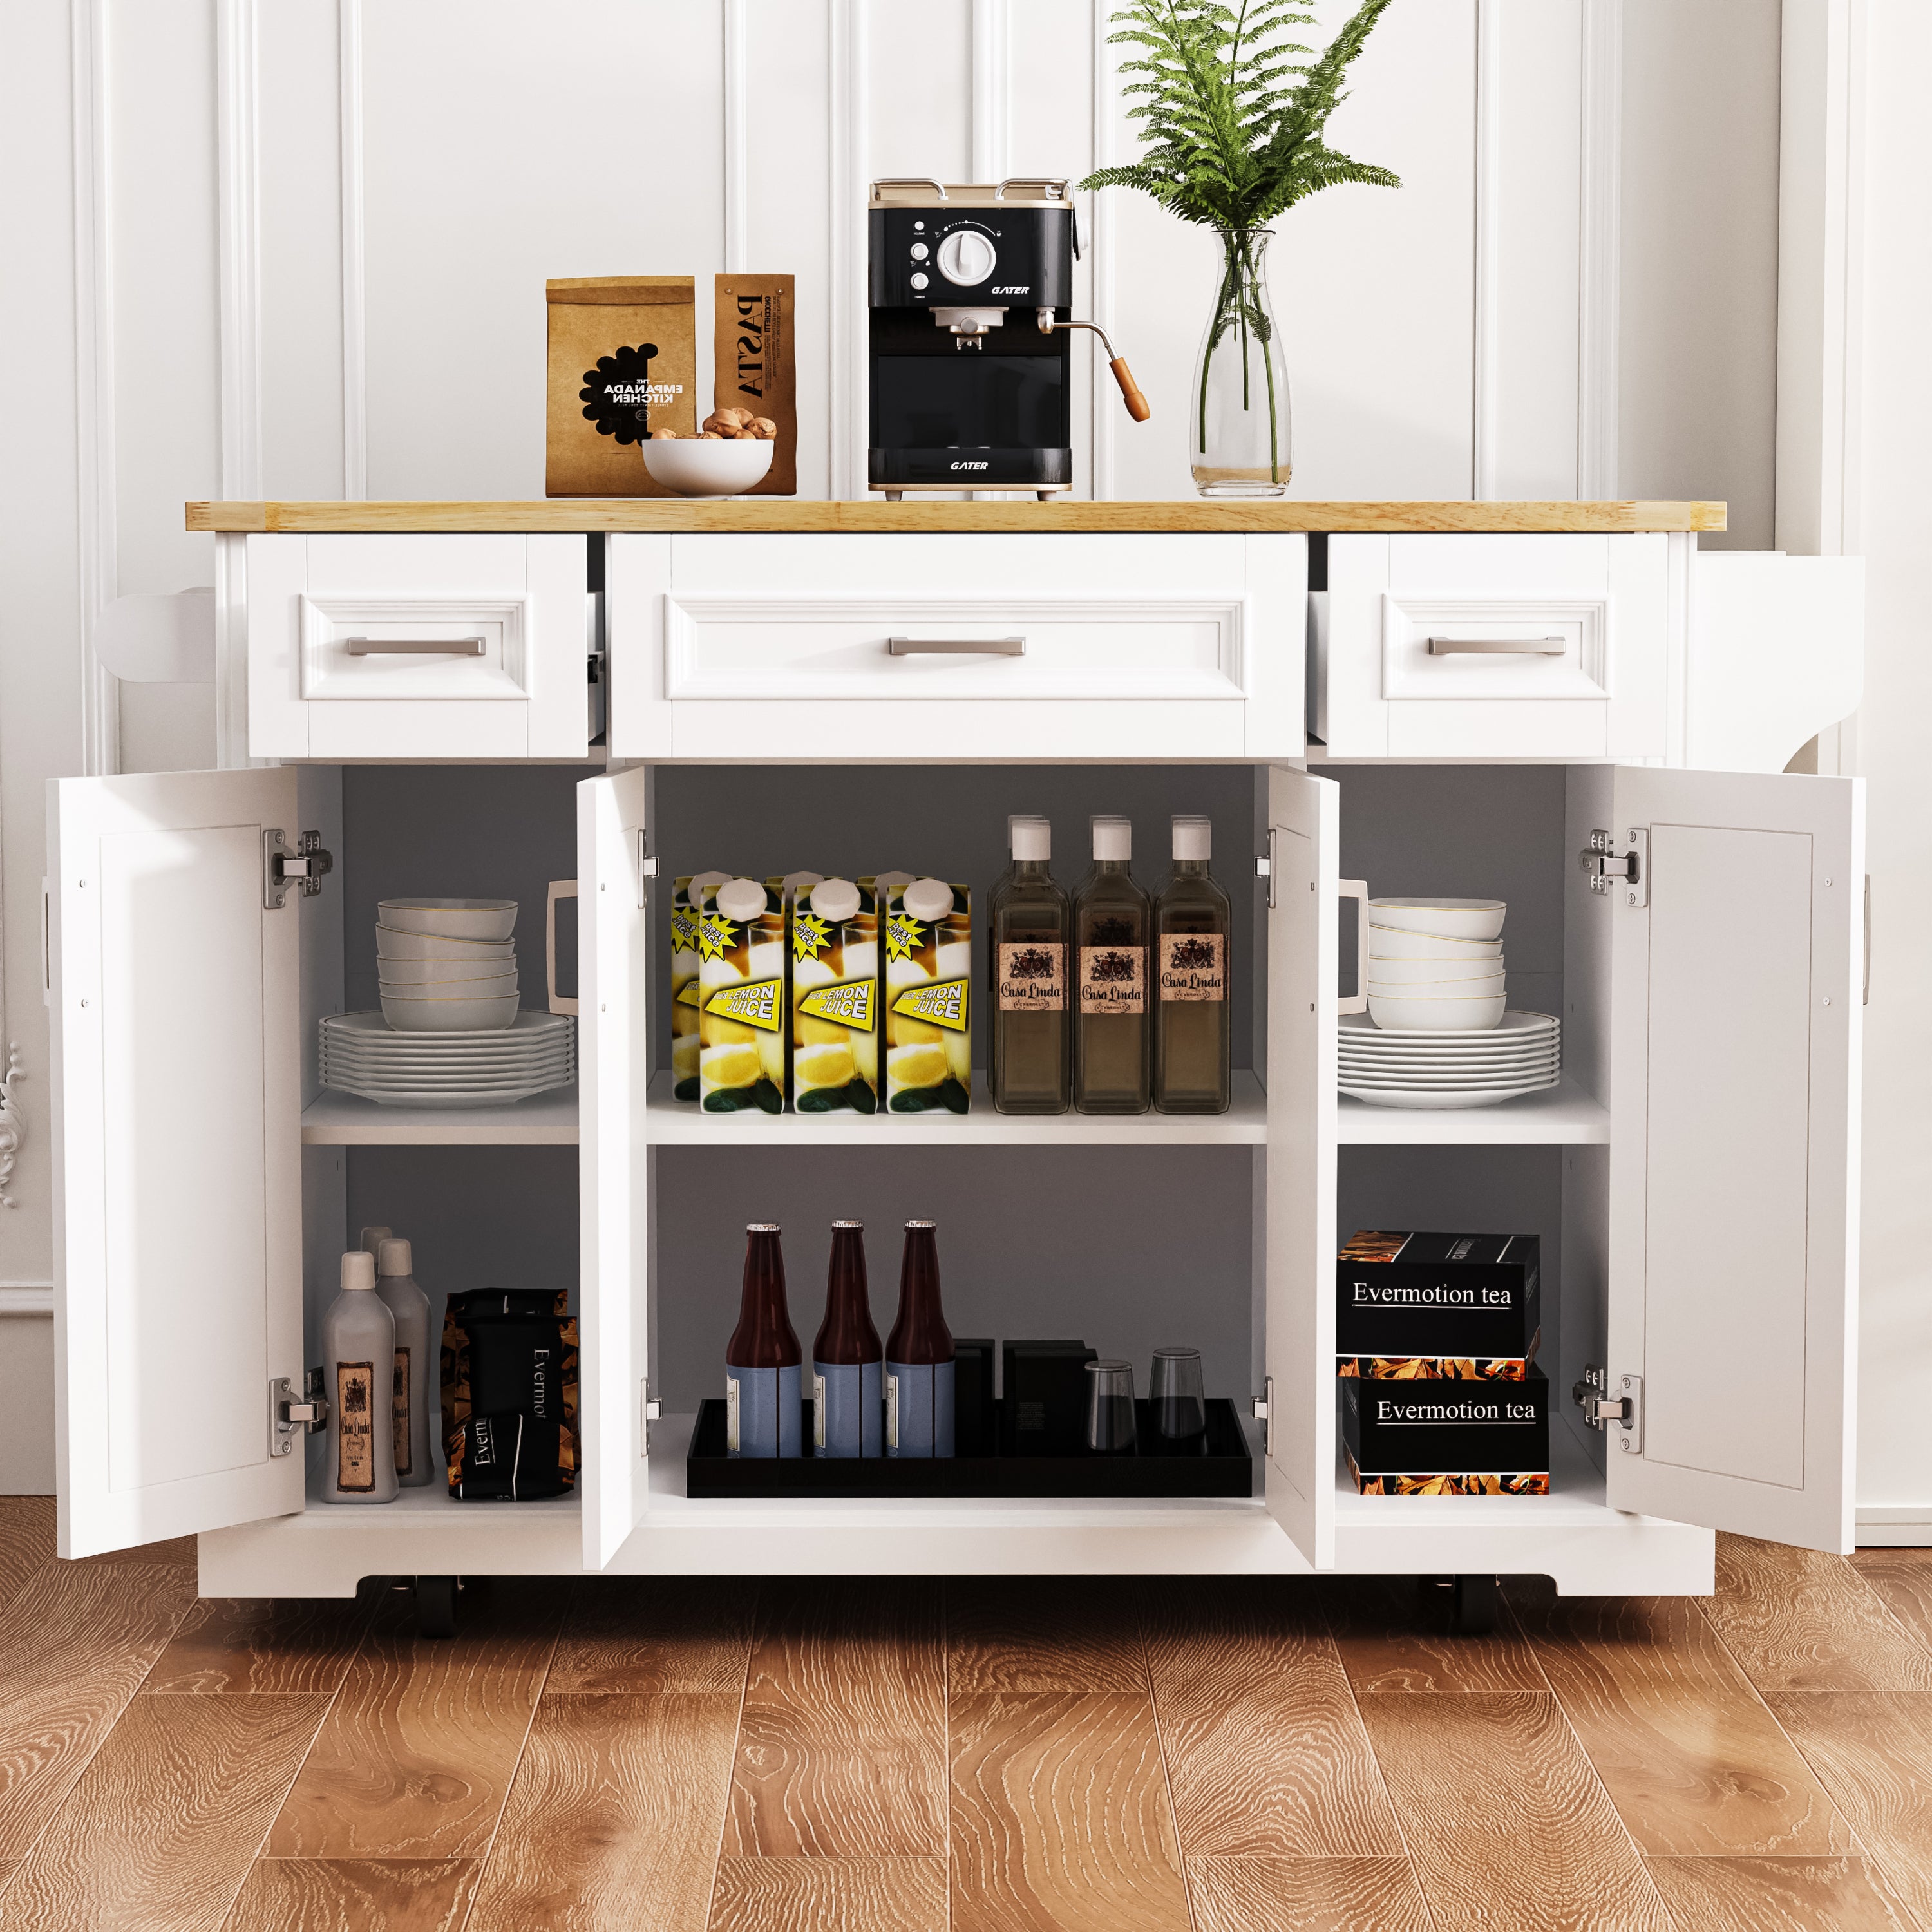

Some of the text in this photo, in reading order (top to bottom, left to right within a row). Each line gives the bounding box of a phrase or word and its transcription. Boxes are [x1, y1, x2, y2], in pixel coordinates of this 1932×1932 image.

[676, 914, 697, 933] best
[705, 922, 725, 942] best
[798, 922, 819, 942] best
[891, 922, 913, 942] best
[1162, 972, 1221, 989] Casa Linda
[728, 985, 775, 999] LEMON
[822, 985, 869, 999] LEMON
[915, 985, 962, 999] LEMON
[1001, 982, 1061, 999] Casa Linda
[1082, 985, 1141, 1002] Casa Linda
[726, 999, 773, 1020] JUICE
[820, 999, 867, 1020] JUICE
[913, 999, 961, 1020] JUICE
[1352, 1282, 1512, 1304] Evermotion tea
[1377, 1400, 1536, 1419] Evermotion tea
[341, 1417, 370, 1436] Casa Linda
